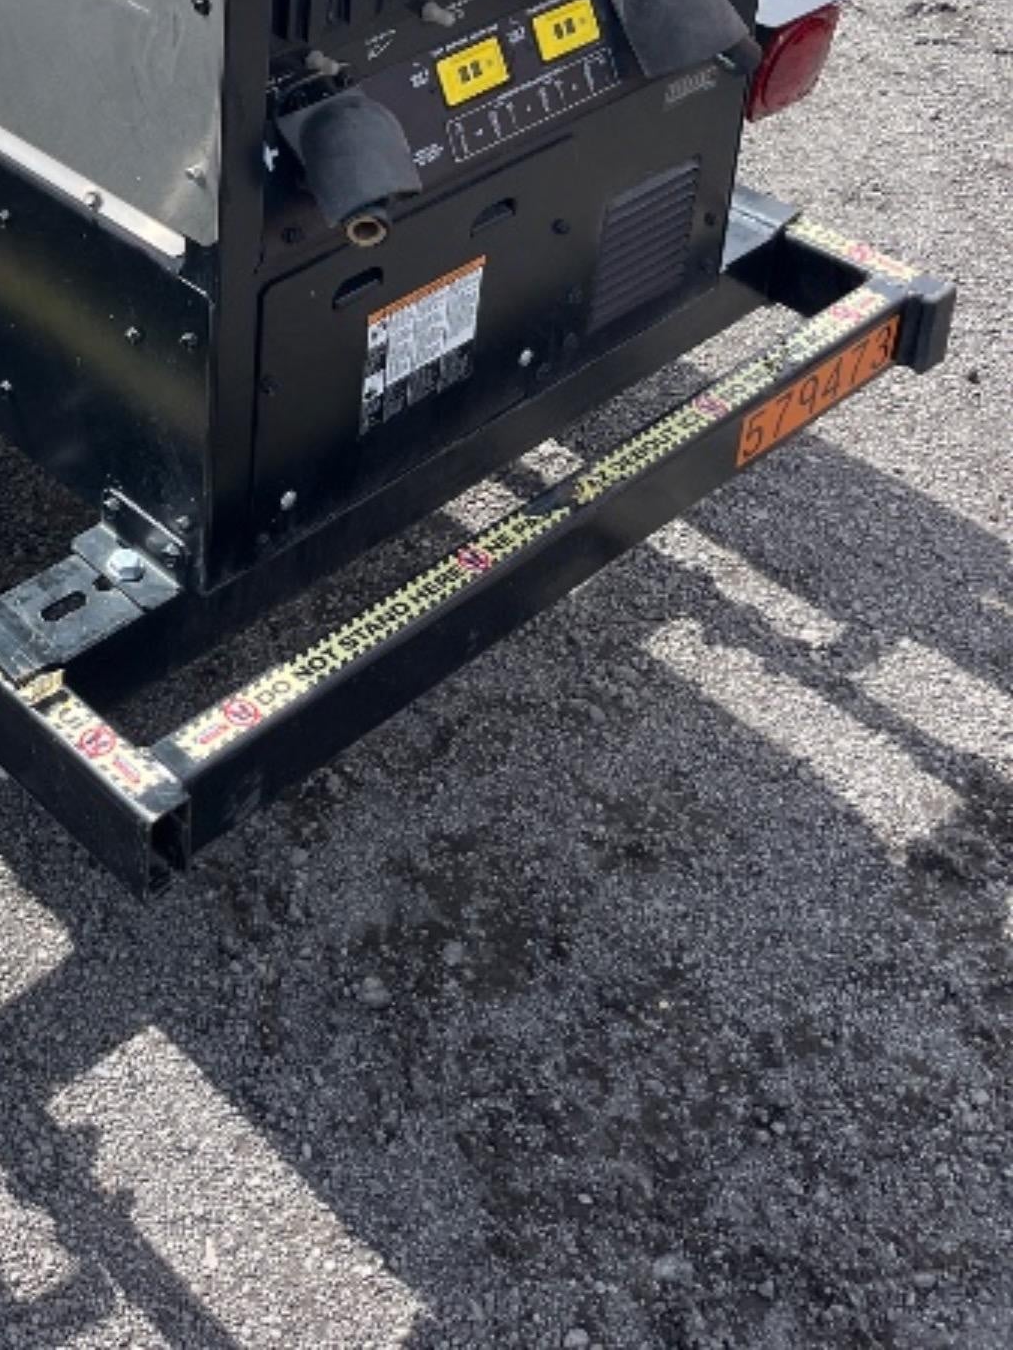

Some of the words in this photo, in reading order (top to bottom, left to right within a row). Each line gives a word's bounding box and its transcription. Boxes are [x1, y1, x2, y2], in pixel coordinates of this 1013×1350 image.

[744, 324, 892, 457] 579473
[255, 677, 292, 708] DO
[292, 645, 340, 683] NOT
[338, 598, 411, 654] STAND
[408, 562, 462, 607] HERE
